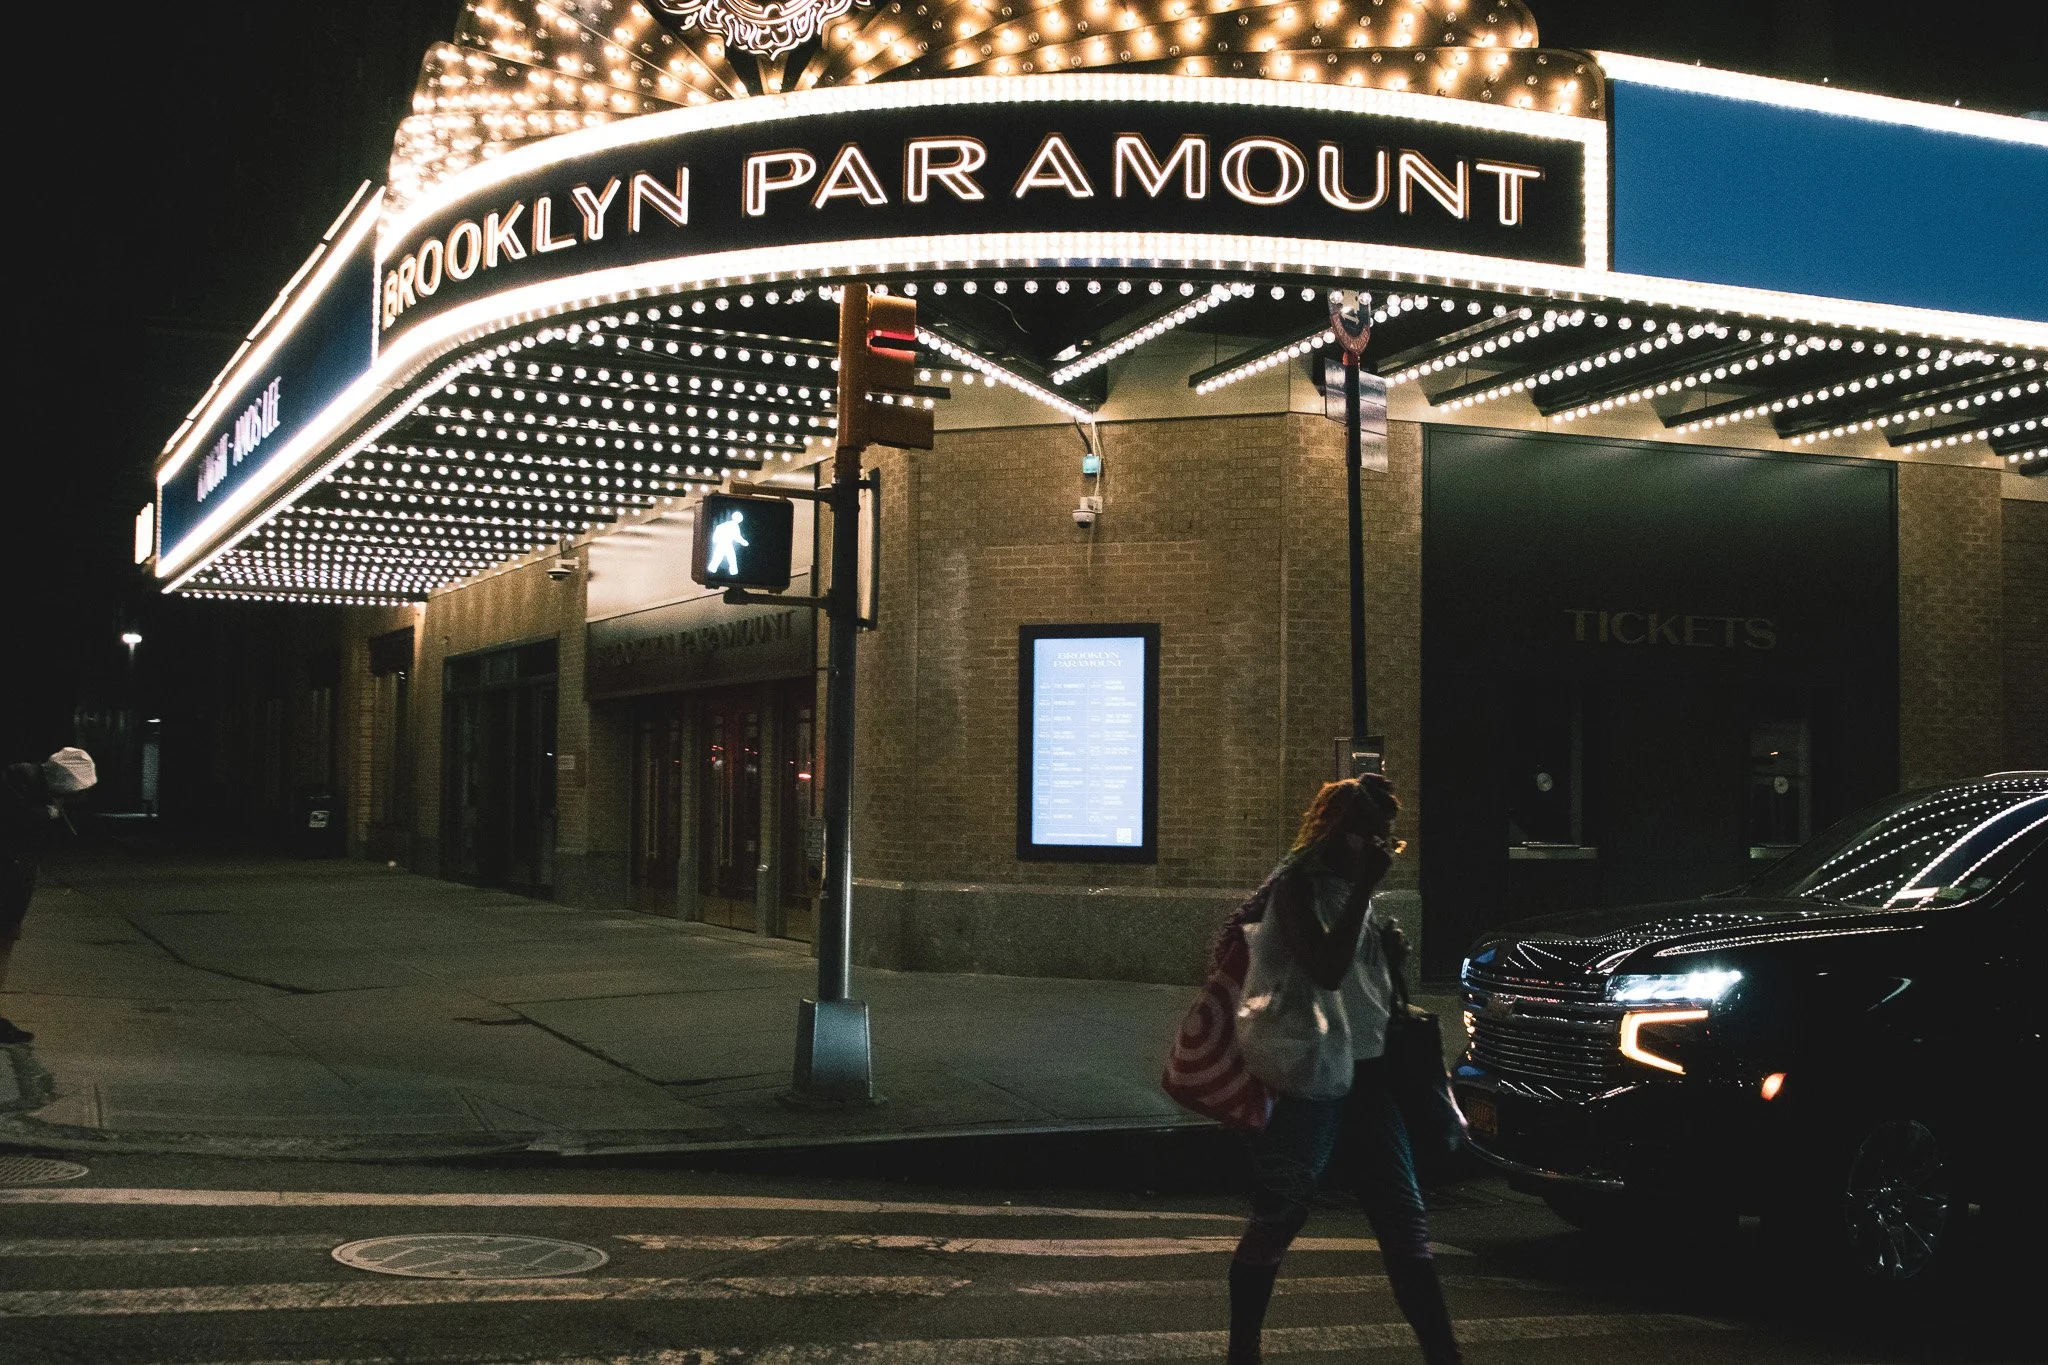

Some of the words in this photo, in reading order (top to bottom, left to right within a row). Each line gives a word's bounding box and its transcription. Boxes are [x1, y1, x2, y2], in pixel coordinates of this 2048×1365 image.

[383, 163, 690, 331] BROOKLYN
[742, 131, 1546, 228] PARAMOUNT
[1563, 608, 1778, 651] TICKETS
[1053, 659, 1124, 668] PARAMOUNT
[1058, 651, 1120, 660] BROOKLYN
